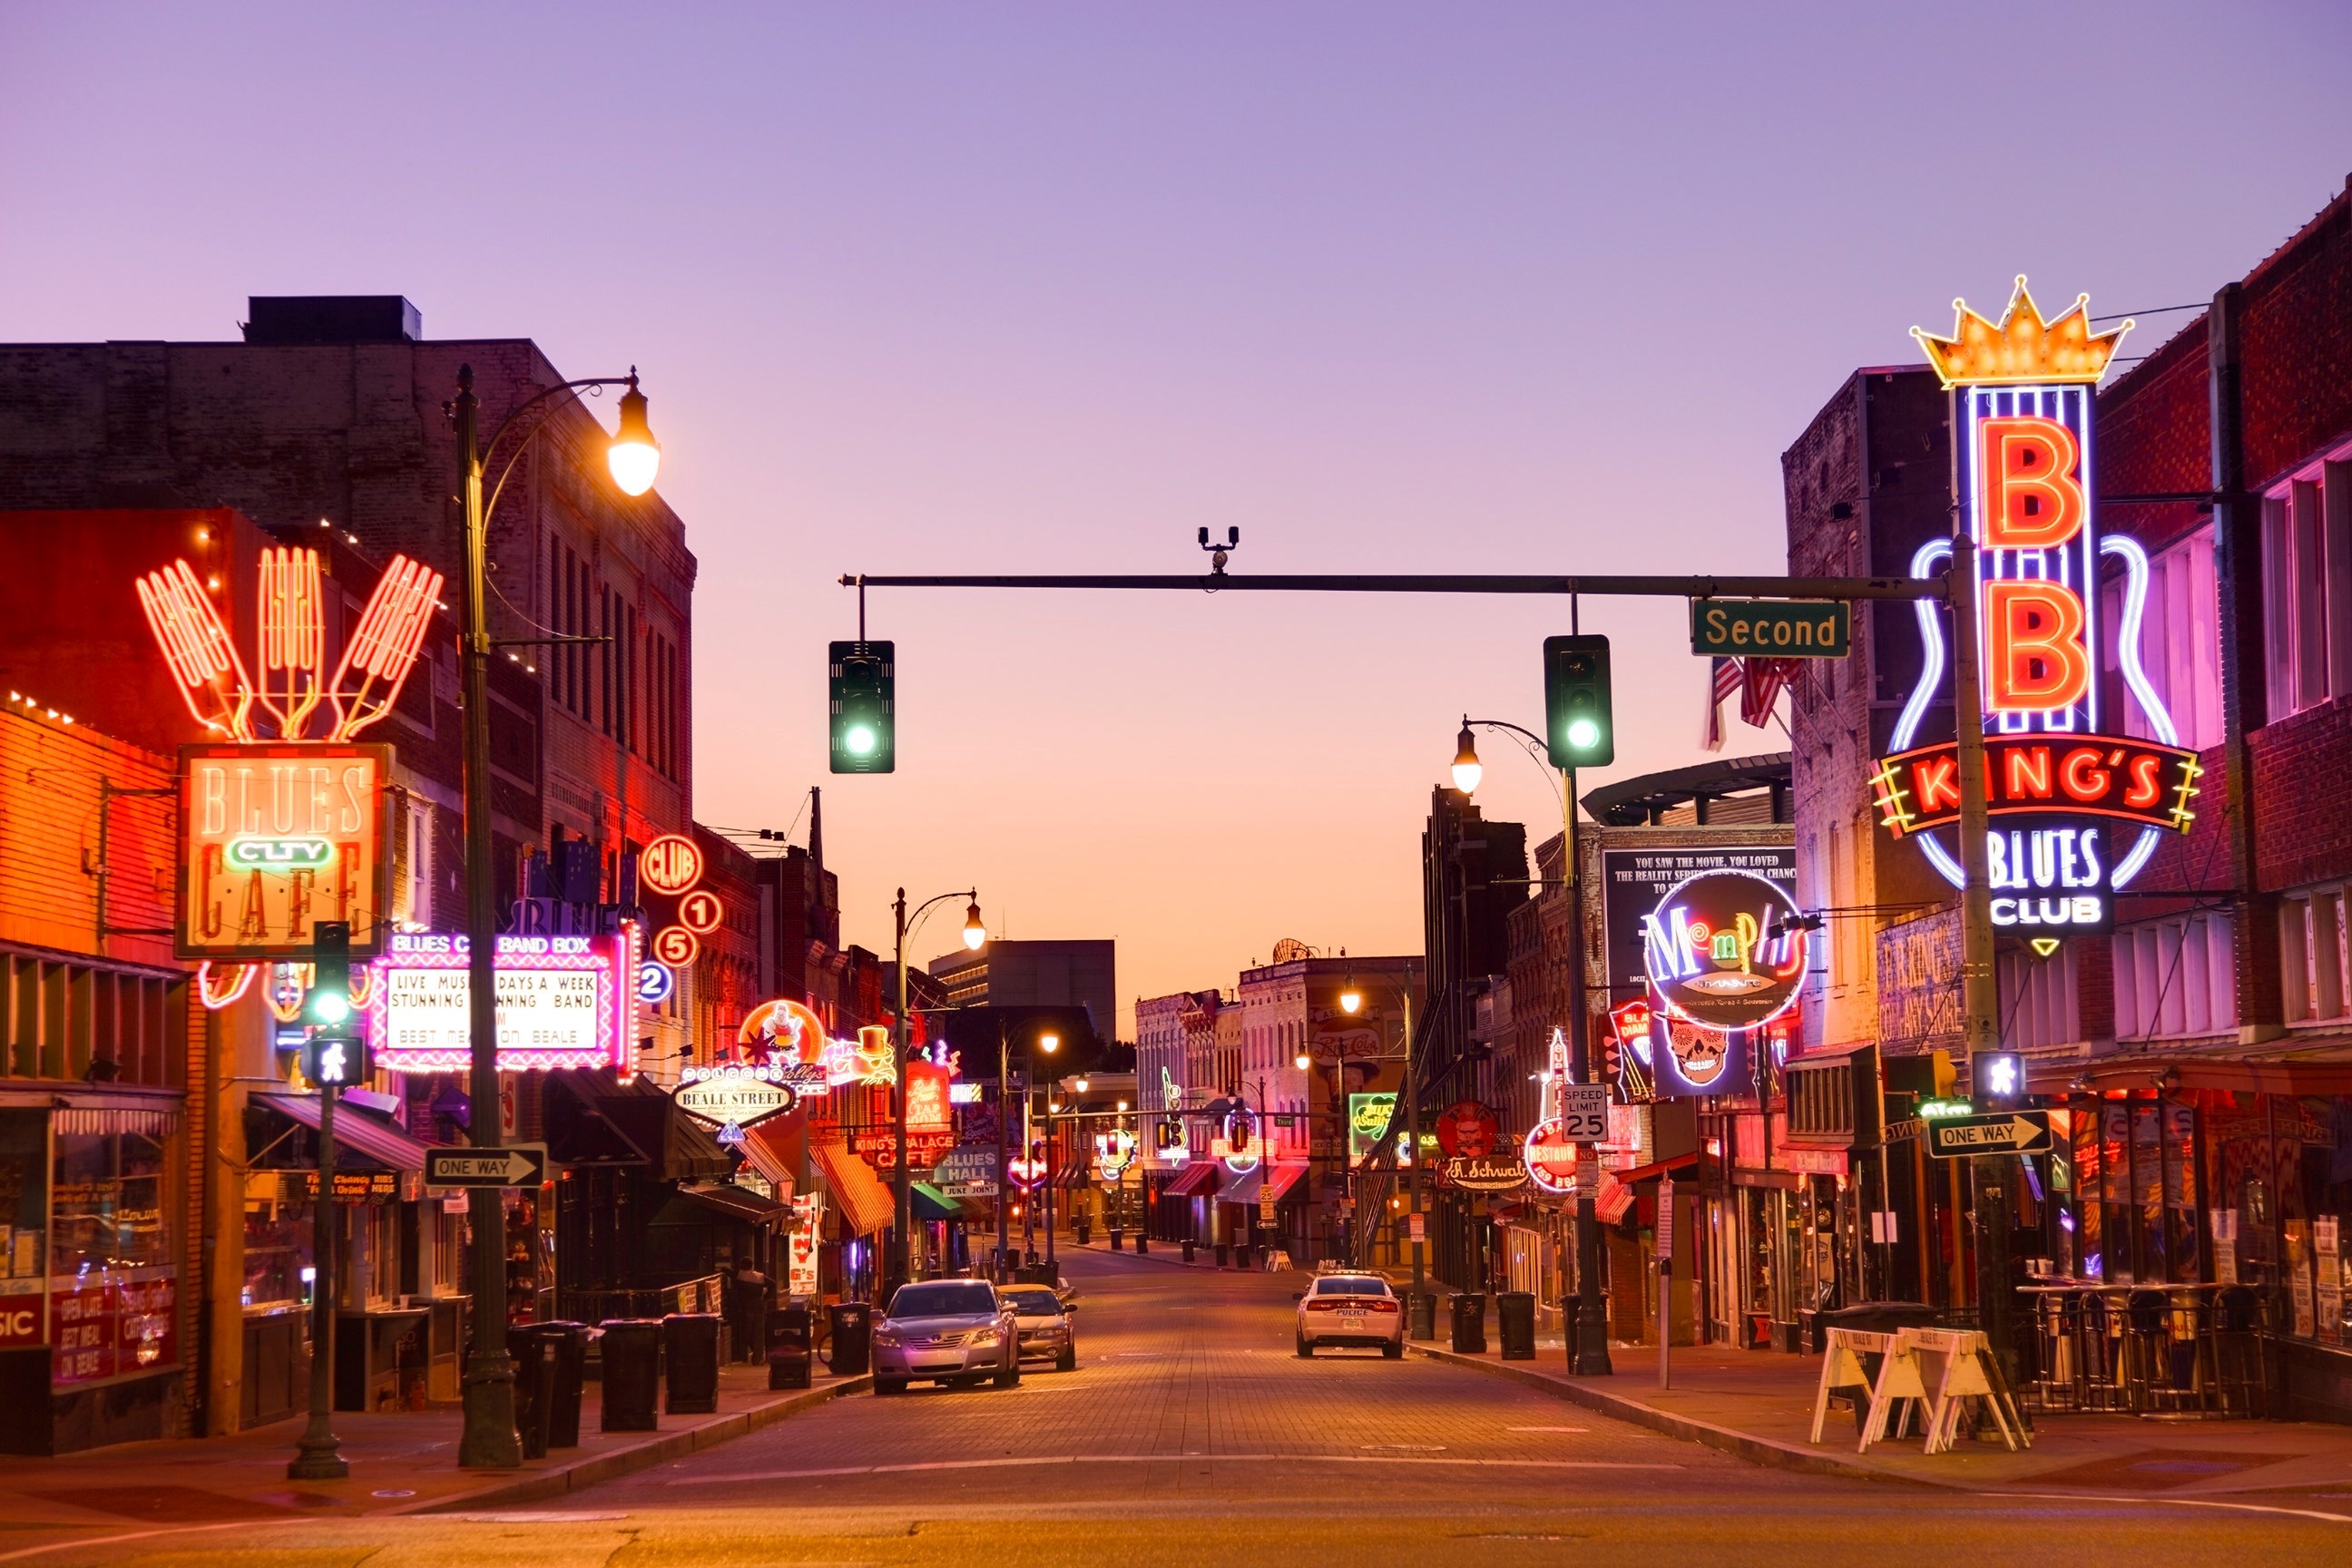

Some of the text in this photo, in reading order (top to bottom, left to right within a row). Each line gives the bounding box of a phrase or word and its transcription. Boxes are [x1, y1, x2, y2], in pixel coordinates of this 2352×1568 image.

[1977, 416, 2084, 549] B
[1706, 609, 1836, 646] Second
[1983, 580, 2089, 713] B
[201, 767, 365, 835] BLUES
[238, 841, 326, 860] CITY
[1987, 828, 2101, 889] BLUES
[648, 842, 695, 887] CLUB
[1635, 855, 1779, 868] YOU SAW THE MOVIE, YOU LOVED
[1615, 870, 1632, 881] THE
[1635, 869, 1672, 881] REALITY
[199, 843, 361, 940] CAFE
[1653, 883, 1666, 894] TO
[691, 898, 707, 926] 1
[1991, 897, 2102, 926] CLUB
[392, 936, 451, 953] BLUES
[499, 936, 548, 953] BAND
[552, 936, 591, 953] BOX
[665, 934, 687, 960] 5
[397, 975, 594, 991] LIVE MUS DAYS A WEEK
[641, 967, 662, 995] 2
[392, 994, 593, 1008] STUNNING NNING BAND
[1624, 1014, 1649, 1024] BLA
[399, 1030, 436, 1044] BEST
[448, 1030, 470, 1044] ME
[533, 1030, 577, 1044] BEALE
[1621, 1025, 1648, 1036] DIAM
[683, 1068, 784, 1080] WELCOME
[796, 1083, 827, 1093] CAFE
[1564, 1091, 1603, 1100] SPEED
[682, 1092, 783, 1105] BEALE STREET
[1569, 1102, 1599, 1112] LIMIT
[1277, 1118, 1292, 1126] Third
[1566, 1114, 1604, 1136] 25
[1944, 1125, 2015, 1144] ONE WAY
[856, 1136, 897, 1152] KING'S
[943, 1152, 996, 1167] BLUES
[1529, 1145, 1577, 1162] RESTAUR
[1579, 1151, 1594, 1160] NO
[439, 1160, 510, 1175] ONE WAY
[948, 1167, 991, 1181] HALL
[1468, 1160, 1528, 1178] Schwab
[334, 1174, 370, 1184] Chance
[373, 1174, 394, 1183] RIBS
[371, 1184, 396, 1193] HERE
[946, 1186, 995, 1195] JUKE JOINT
[62, 1296, 103, 1321] OPEN LATE
[0, 1310, 34, 1337] IC
[61, 1324, 102, 1351] BEST MEAL
[1852, 1333, 1866, 1345] BEALE
[62, 1350, 100, 1377] ON BEALE
